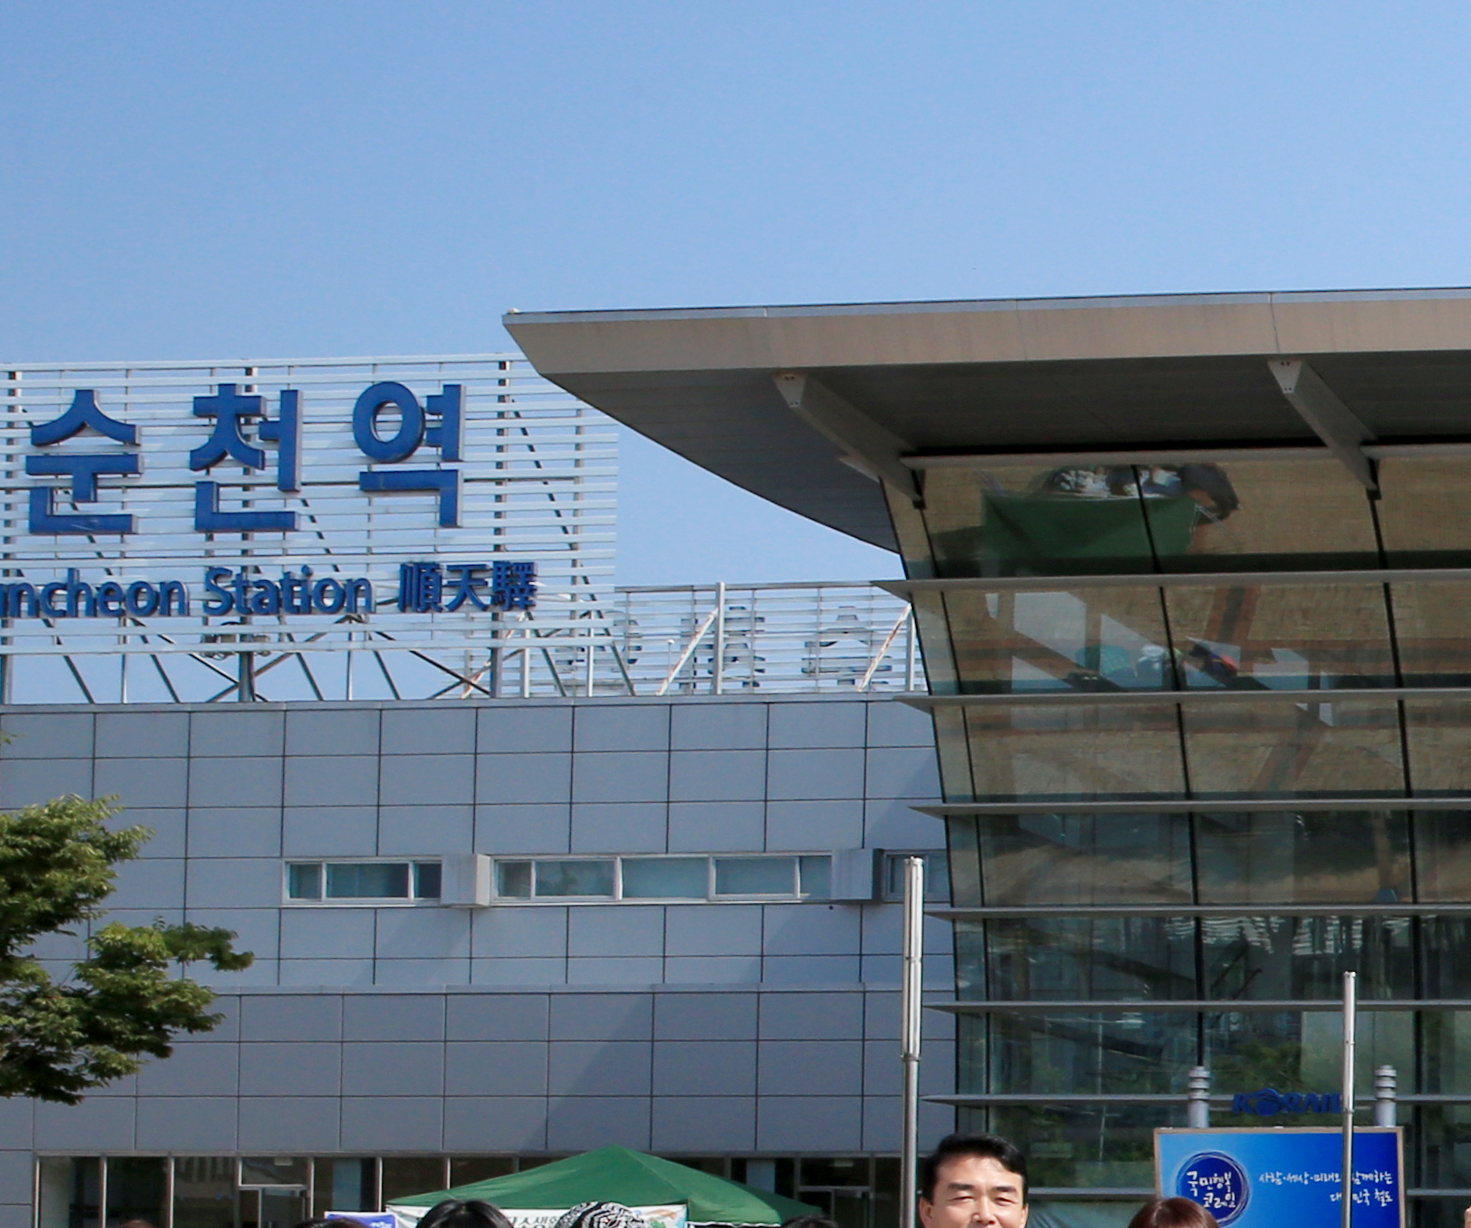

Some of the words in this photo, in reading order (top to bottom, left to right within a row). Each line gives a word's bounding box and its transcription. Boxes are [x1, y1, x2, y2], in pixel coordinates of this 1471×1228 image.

[24, 381, 467, 535] 순천역
[203, 563, 378, 617] Station
[1186, 1170, 1232, 1197] 국민행복
[1203, 1192, 1236, 1209] 코레일
[1329, 1189, 1370, 1207] 대민국
